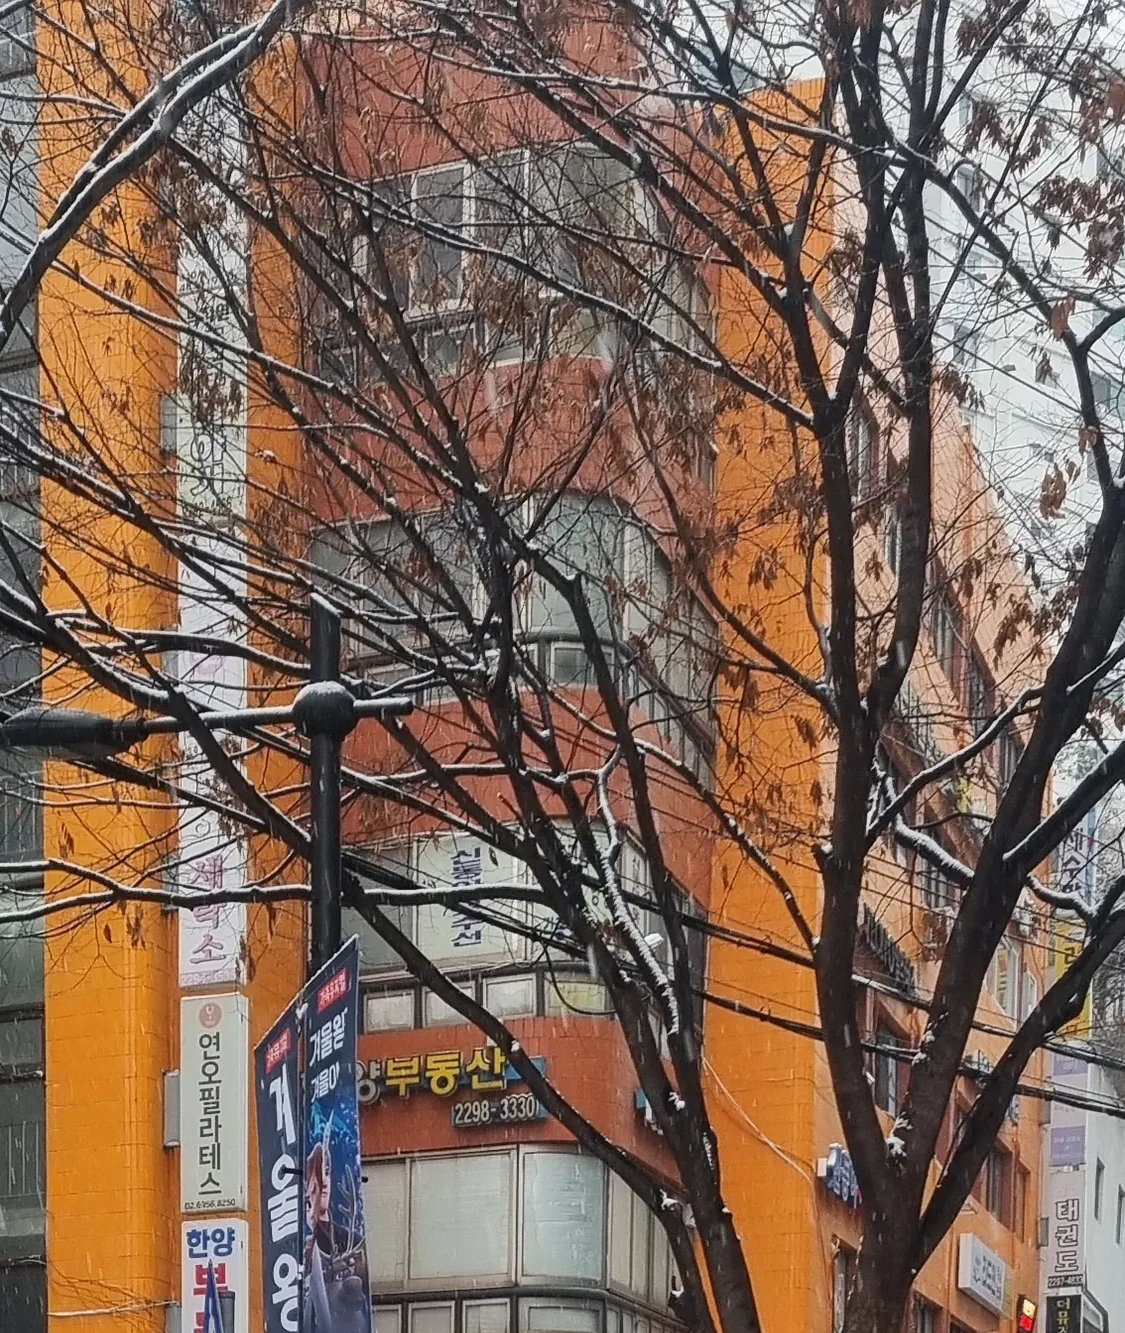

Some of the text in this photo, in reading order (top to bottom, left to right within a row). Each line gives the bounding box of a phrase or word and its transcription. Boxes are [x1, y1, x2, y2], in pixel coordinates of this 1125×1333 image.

[198, 1032, 222, 1196] 연오필라테스
[454, 1095, 537, 1126] 2298-3330
[186, 1227, 236, 1259] 한양
[1054, 1198, 1080, 1273] 태권도
